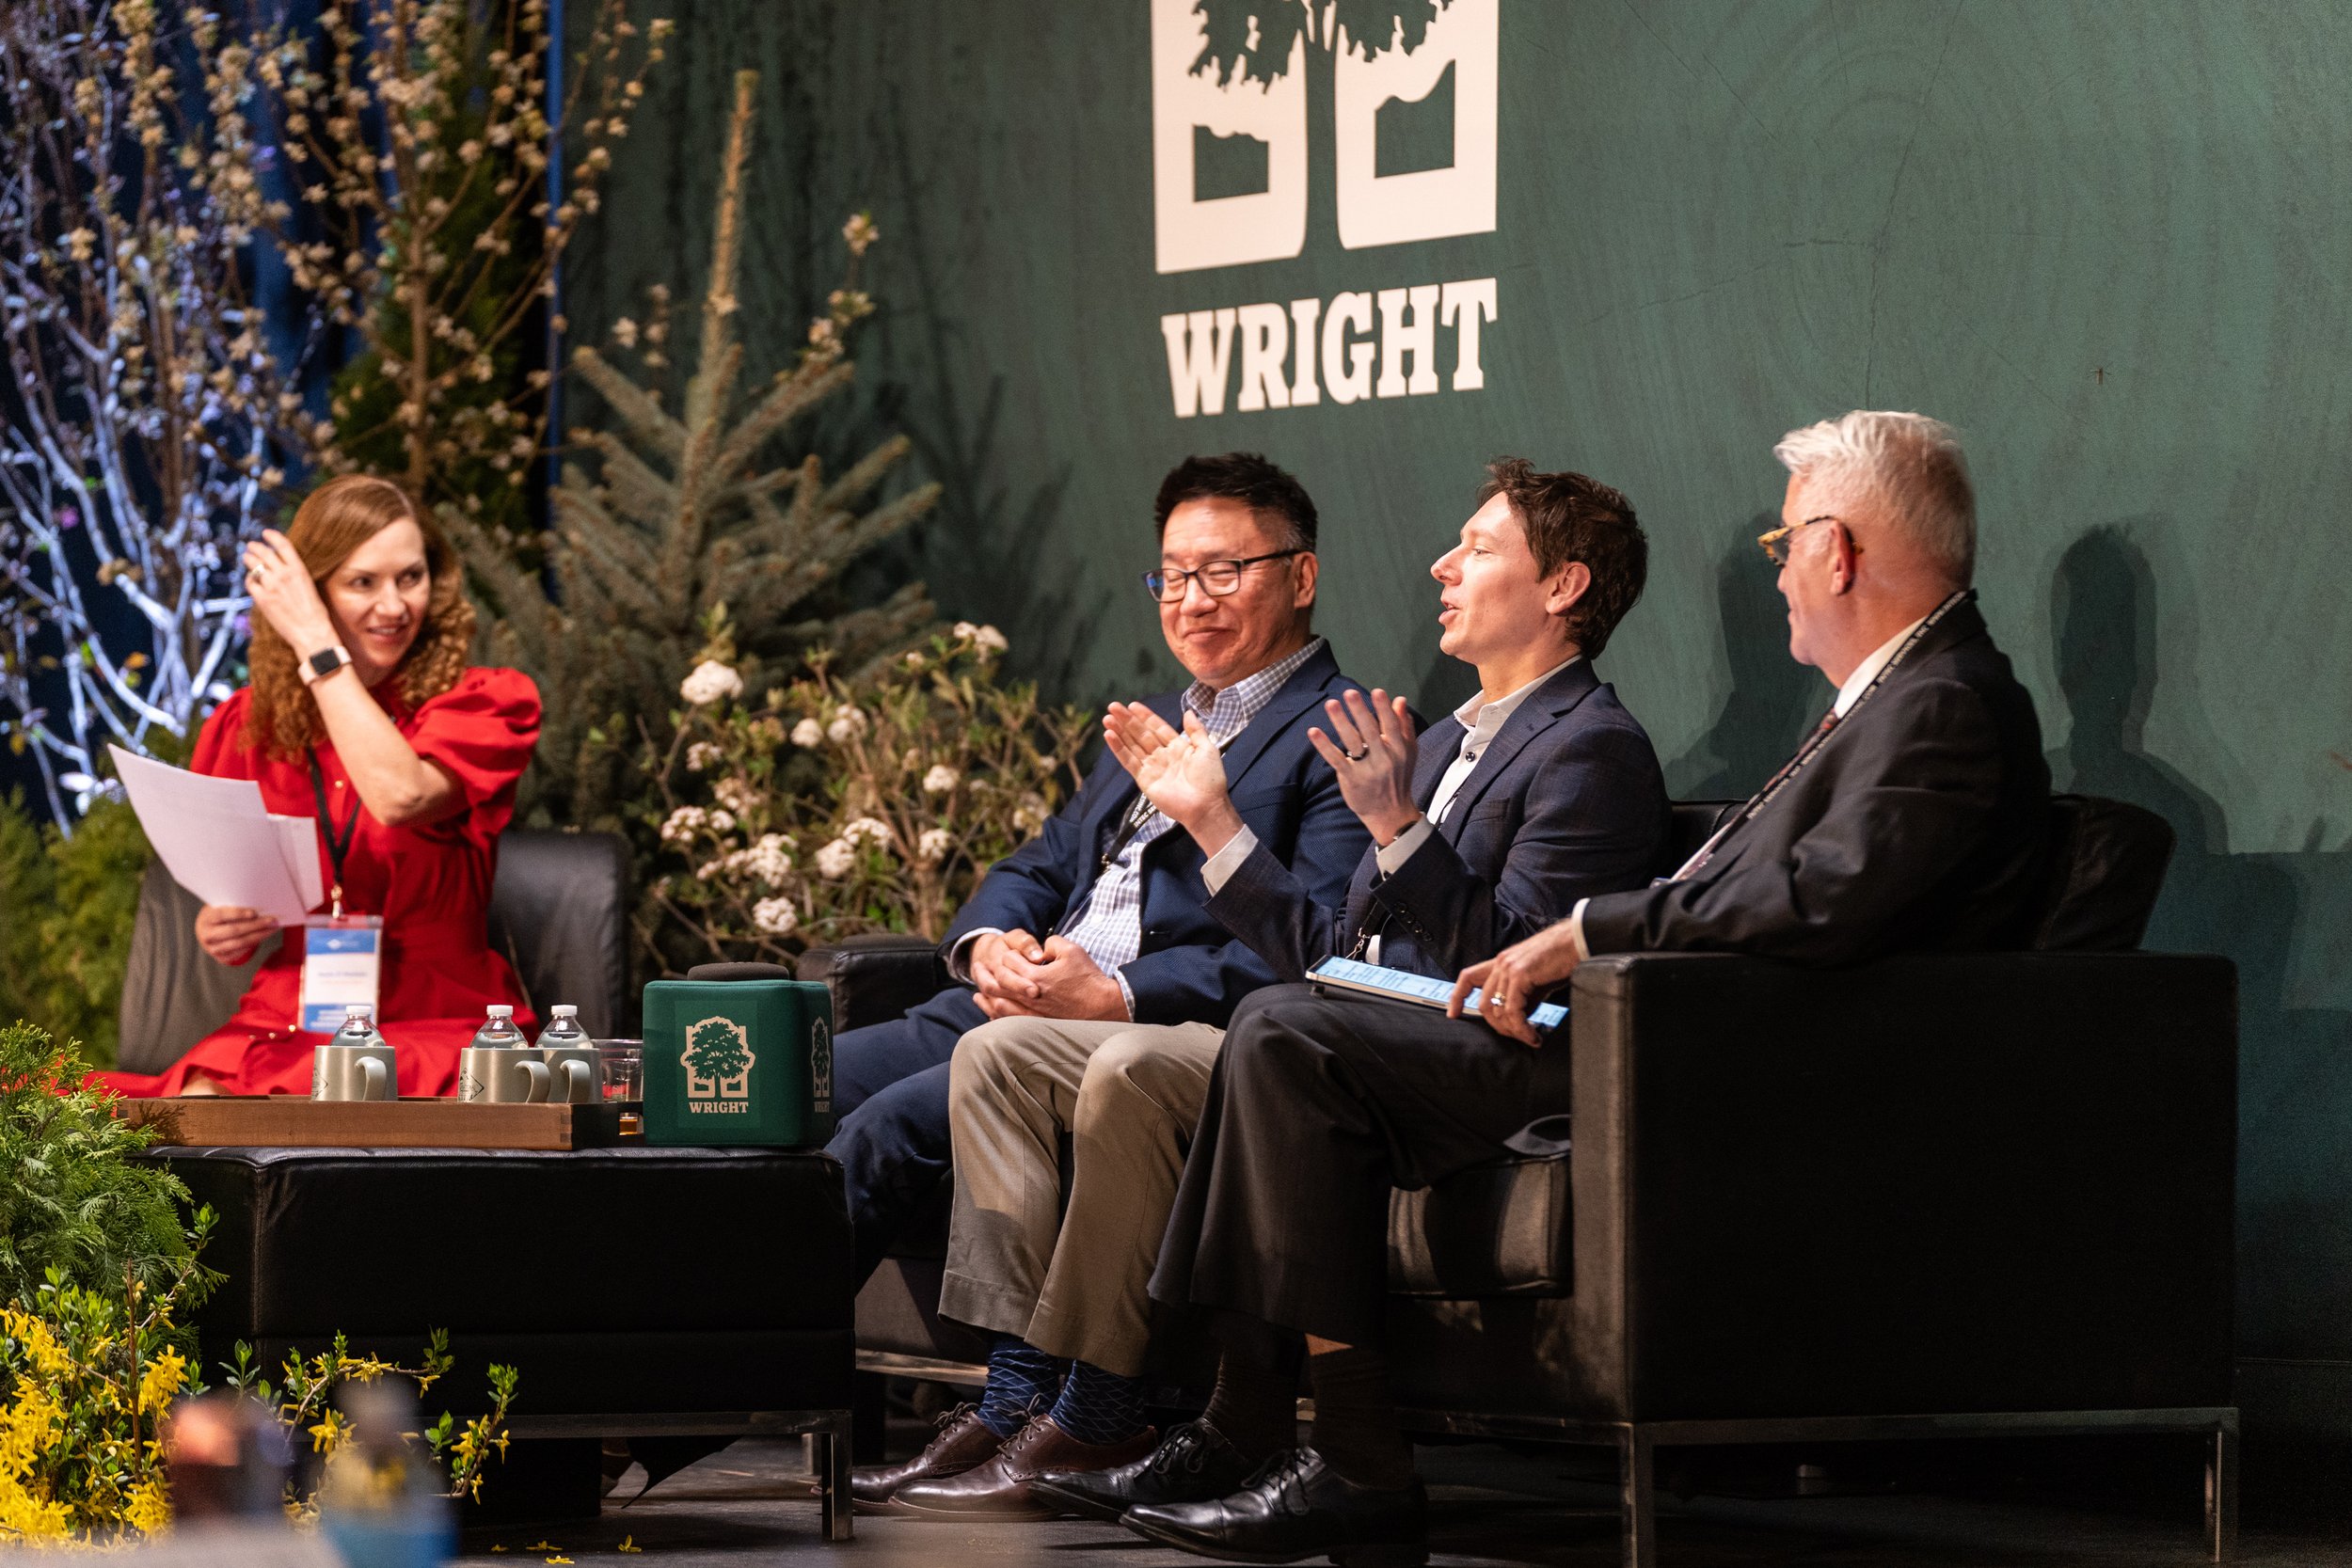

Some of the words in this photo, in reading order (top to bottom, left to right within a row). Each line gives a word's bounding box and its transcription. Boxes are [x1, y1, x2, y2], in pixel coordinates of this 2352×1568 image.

[1160, 277, 1498, 419] WRIGHT
[1133, 811, 1149, 828] INTEC
[689, 1101, 749, 1114] WRIGHT
